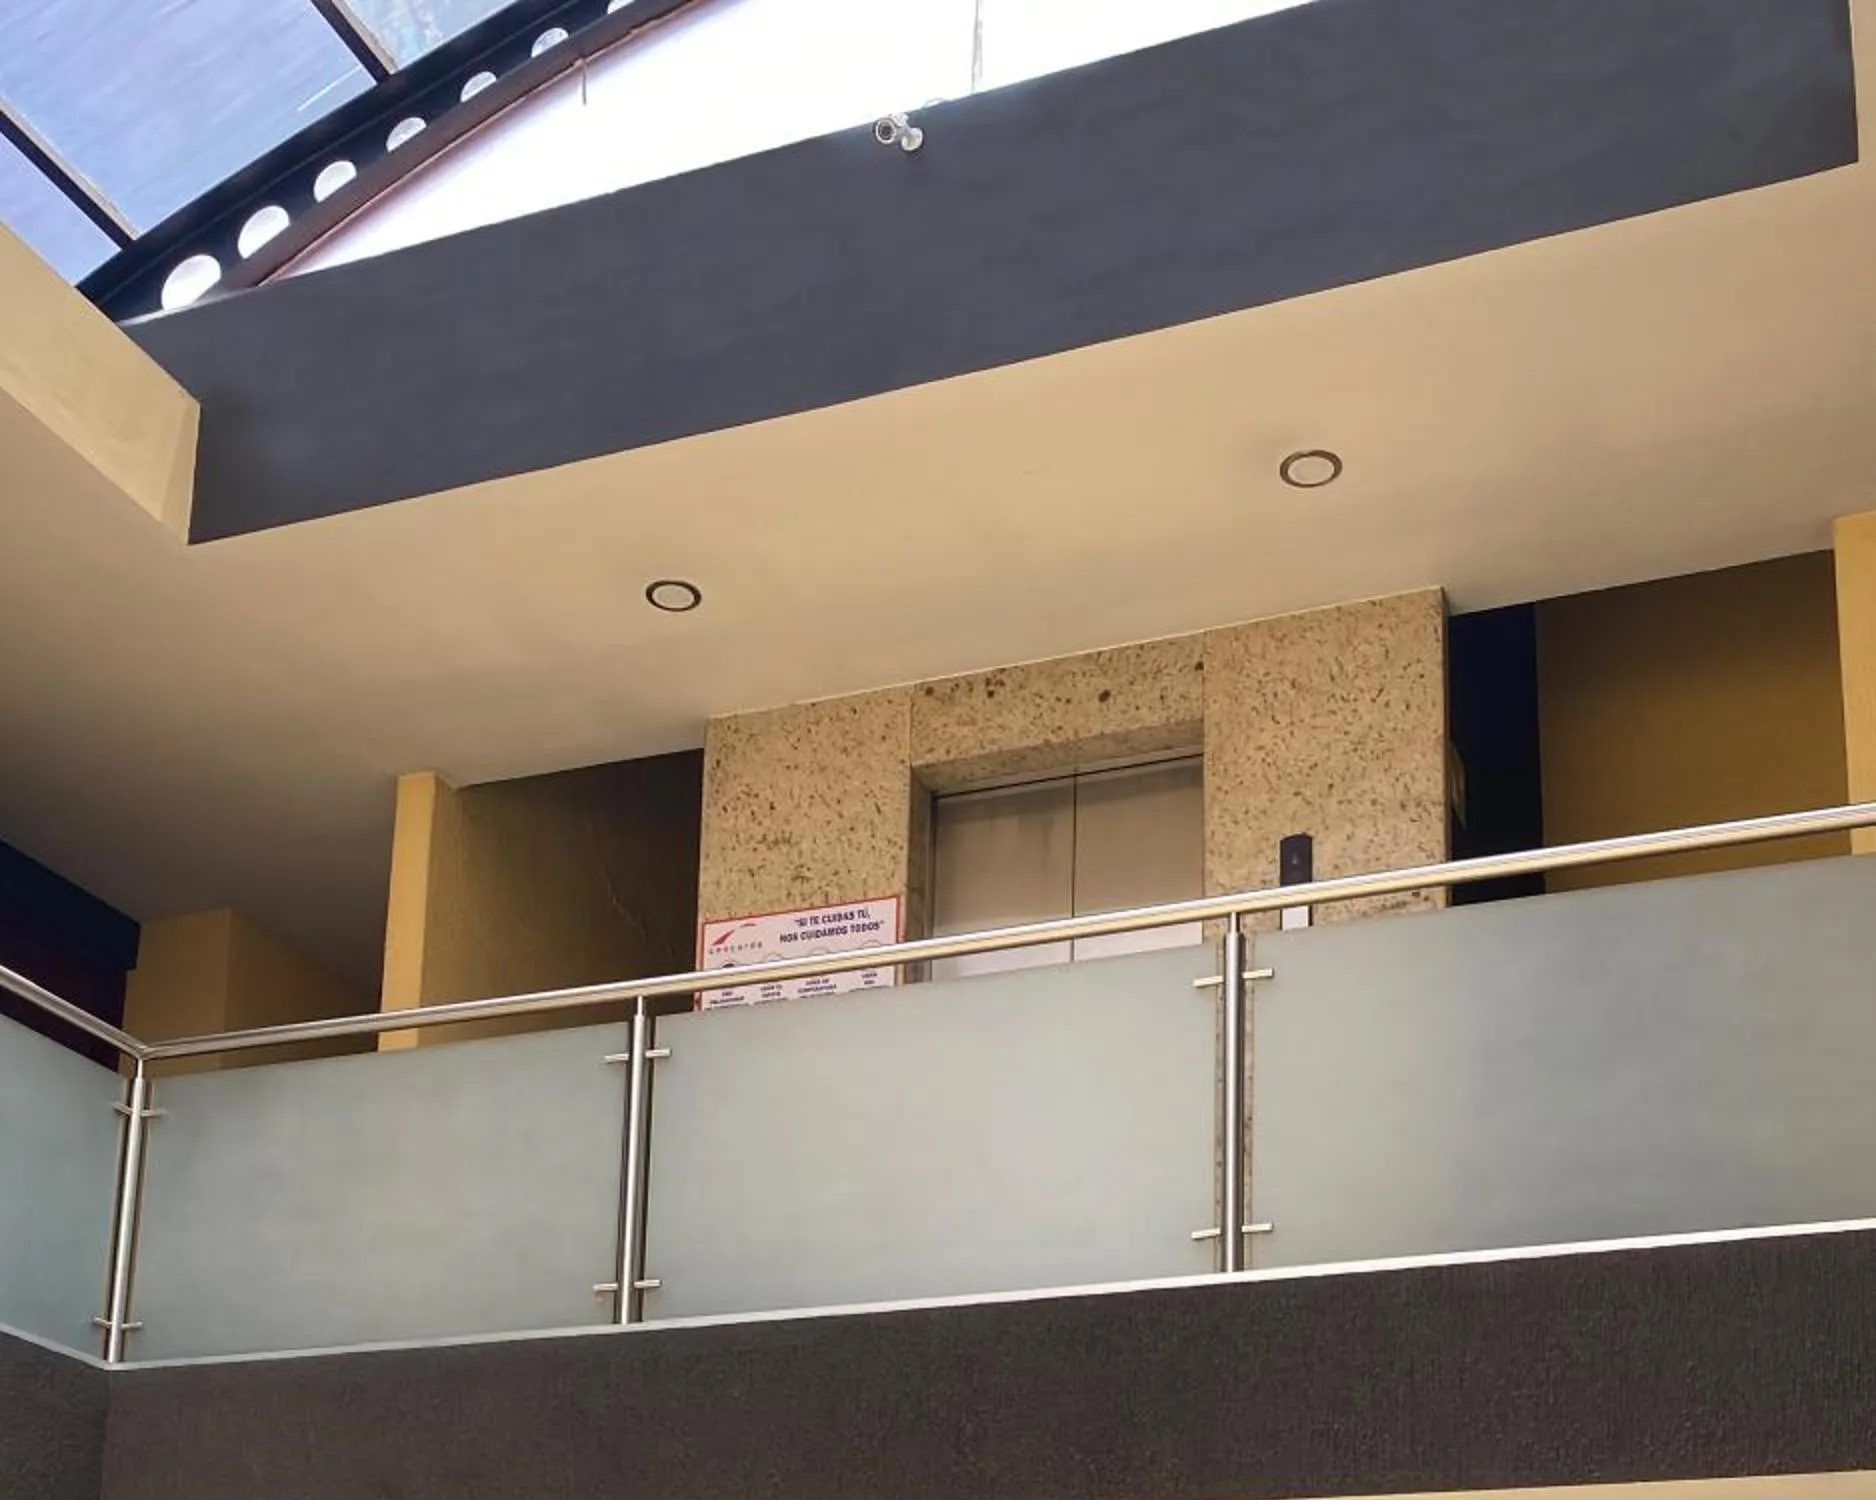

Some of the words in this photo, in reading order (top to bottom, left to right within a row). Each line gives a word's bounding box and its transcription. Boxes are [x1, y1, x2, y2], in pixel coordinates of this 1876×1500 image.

[821, 911, 855, 925] CUIDAS
[779, 931, 799, 944] NOS
[800, 925, 848, 942] CUIDAMOS
